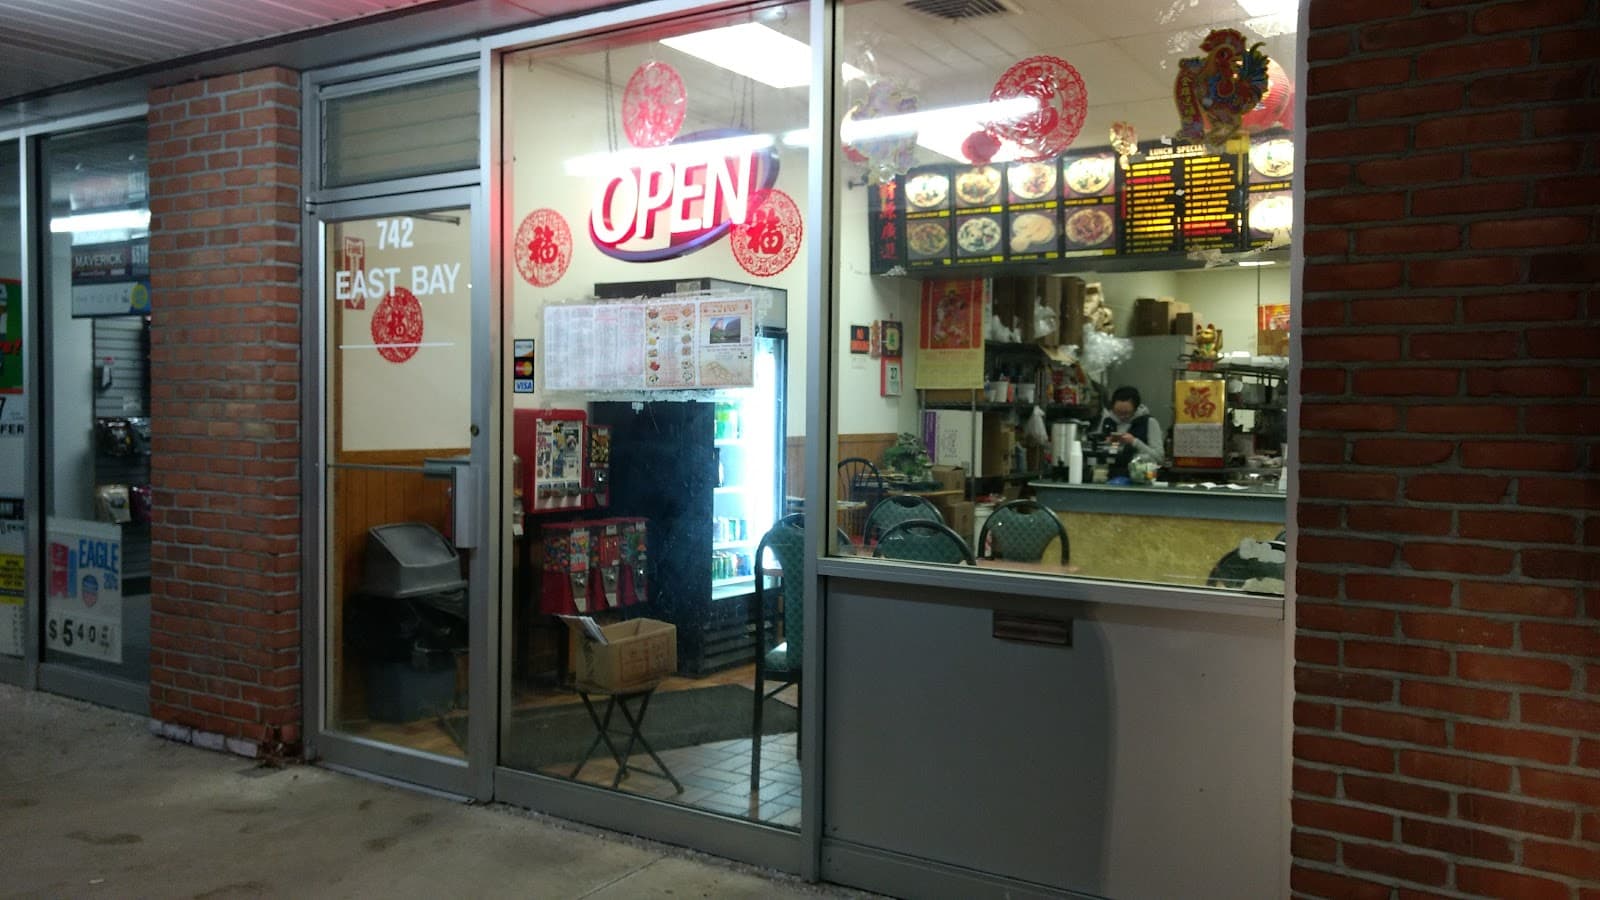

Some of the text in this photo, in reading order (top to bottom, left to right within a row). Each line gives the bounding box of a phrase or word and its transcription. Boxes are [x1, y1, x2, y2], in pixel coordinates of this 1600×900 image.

[1149, 146, 1173, 156] LUNCH
[589, 148, 754, 244] OPEN
[376, 217, 414, 250] 742
[335, 263, 461, 300] EAST BAY
[79, 537, 119, 574] EAGLE
